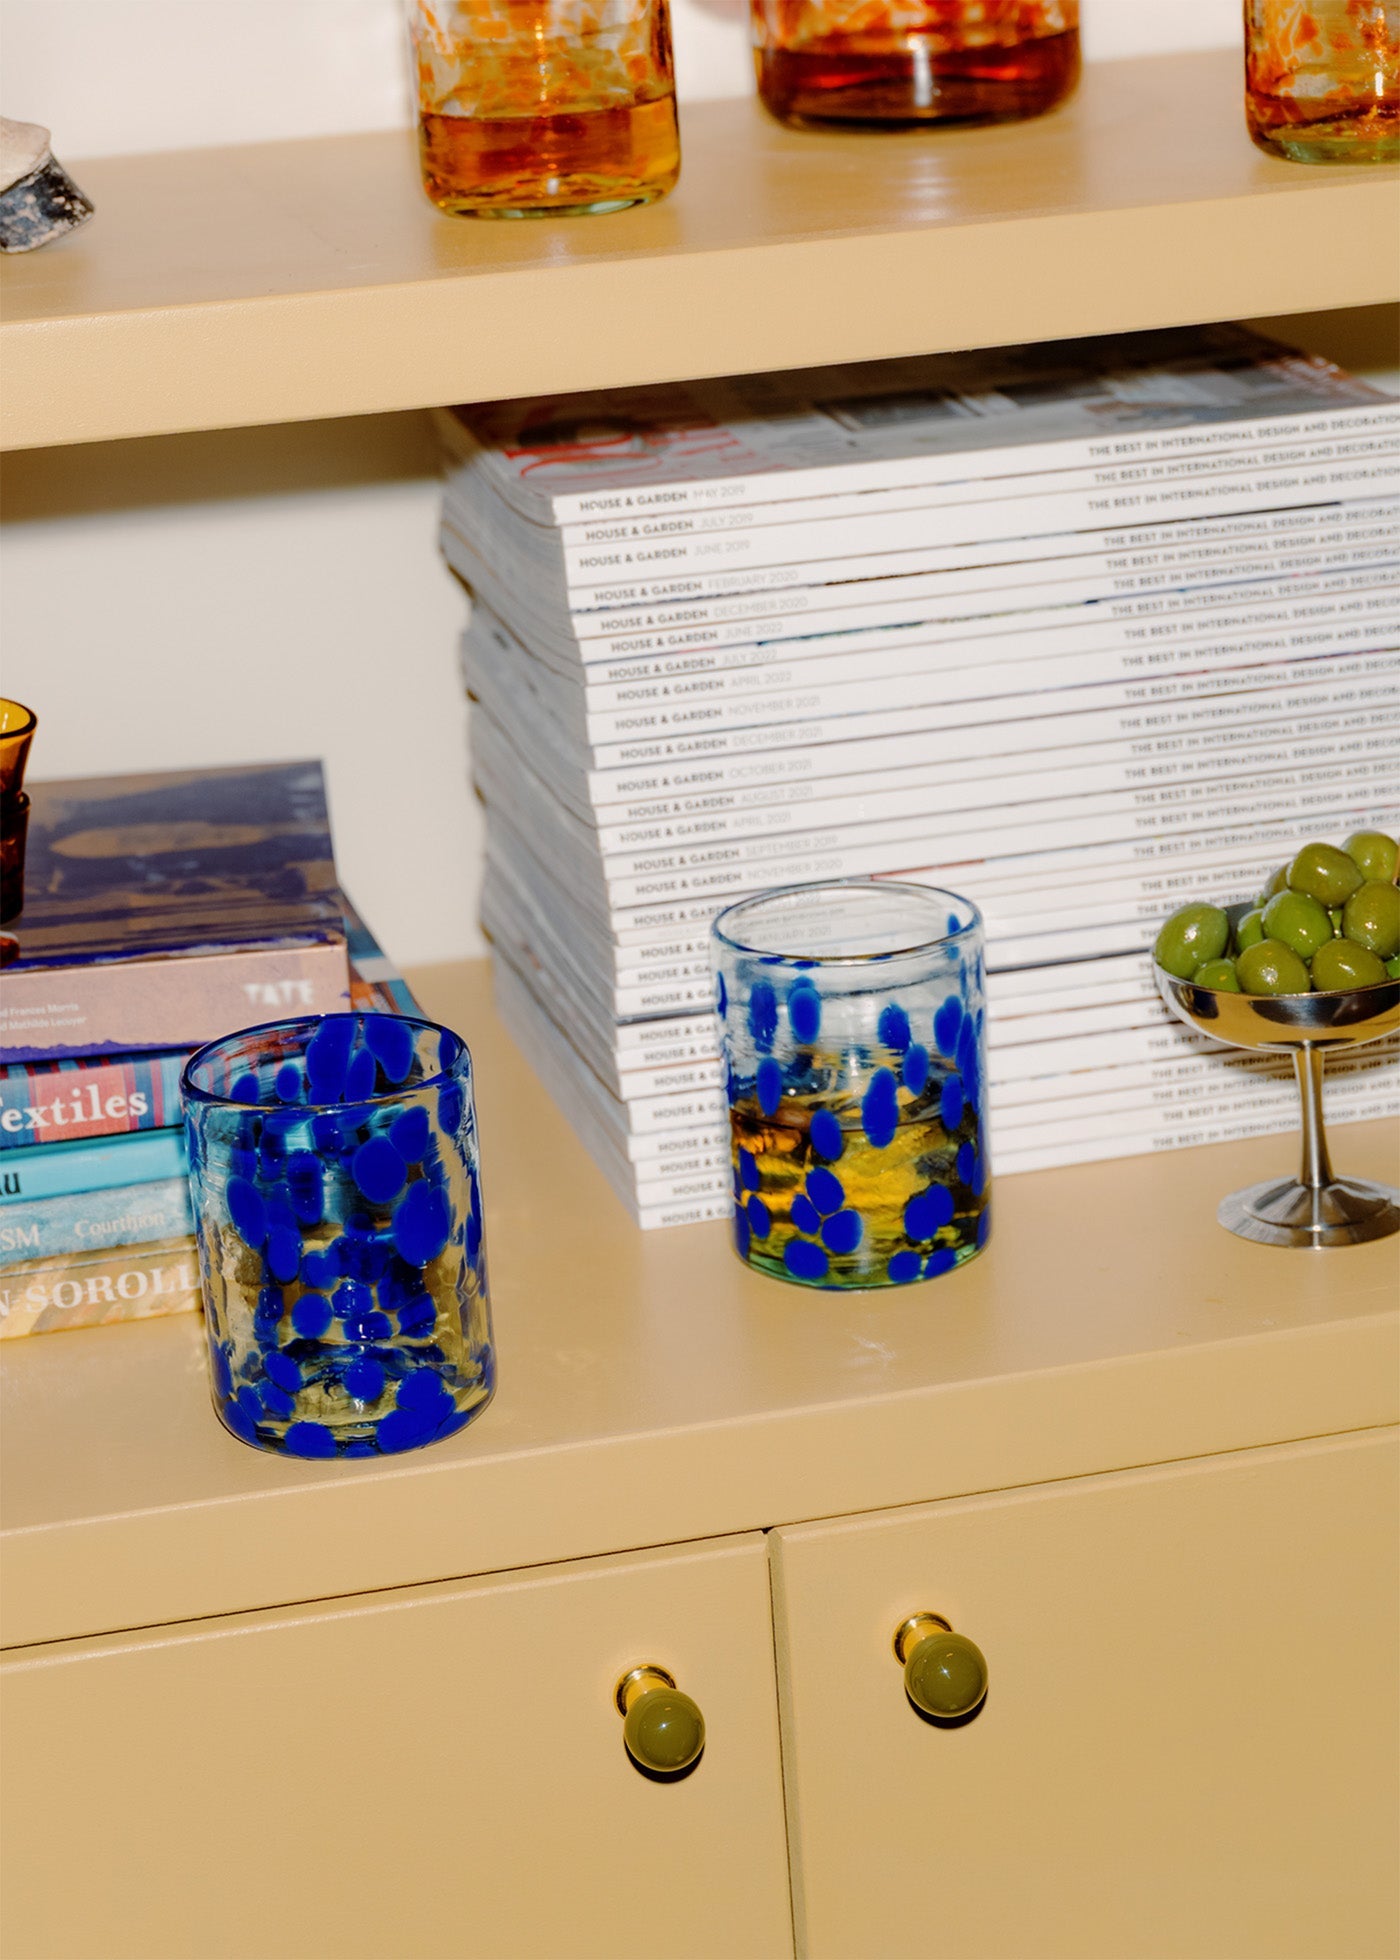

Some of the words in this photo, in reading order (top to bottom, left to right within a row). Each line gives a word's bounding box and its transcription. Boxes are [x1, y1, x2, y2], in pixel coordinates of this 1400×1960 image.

[1089, 445, 1110, 456] THE
[1114, 442, 1141, 453] BEST
[1146, 440, 1157, 450] IN
[1161, 430, 1252, 449] INTERNATIONAL
[1258, 426, 1299, 439] DESIGN
[1304, 423, 1327, 434] AND
[1095, 471, 1116, 482] THE
[1120, 468, 1147, 480] BEST
[1152, 466, 1163, 476] IN
[1167, 456, 1258, 475] INTERNATIONAL
[1263, 451, 1305, 465] DESIGN
[1310, 449, 1333, 460] AND
[580, 498, 621, 512] HOUSE
[626, 497, 632, 507] &
[636, 491, 686, 506] GARDEN
[1088, 498, 1109, 509] THE
[1114, 495, 1140, 507] BEST
[1146, 493, 1156, 503] IN
[1160, 483, 1252, 502] INTERNATIONAL
[1256, 478, 1298, 492] DESIGN
[1303, 475, 1326, 487] AND
[586, 527, 627, 541] HOUSE
[632, 526, 638, 536] &
[643, 520, 692, 535] GARDEN
[1104, 534, 1124, 546] THE
[1129, 531, 1156, 543] BEST
[1161, 529, 1172, 539] IN
[1177, 519, 1267, 538] INTERNATIONAL
[1272, 514, 1314, 527] DESIGN
[1319, 511, 1342, 522] AND
[579, 554, 621, 568] HOUSE
[625, 553, 632, 563] &
[637, 547, 686, 562] GARDEN
[1107, 557, 1127, 568] THE
[1132, 554, 1158, 565] BEST
[1164, 552, 1174, 562] IN
[1178, 541, 1268, 560] INTERNATIONAL
[1273, 536, 1315, 550] DESIGN
[1320, 533, 1342, 545] AND
[594, 587, 636, 601] HOUSE
[640, 586, 647, 596] &
[651, 580, 702, 595] GARDEN
[601, 616, 642, 630] HOUSE
[647, 614, 653, 625] &
[658, 608, 707, 623] GARDEN
[611, 638, 652, 652] HOUSE
[657, 636, 663, 647] &
[668, 630, 717, 645] GARDEN
[609, 665, 649, 679] HOUSE
[654, 663, 661, 674] &
[665, 657, 715, 672] GARDEN
[617, 686, 658, 700] HOUSE
[663, 685, 669, 695] &
[673, 679, 724, 694] GARDEN
[615, 715, 656, 729] HOUSE
[660, 714, 667, 724] &
[671, 707, 721, 723] GARDEN
[620, 745, 661, 759] HOUSE
[666, 744, 672, 754] &
[677, 737, 726, 753] GARDEN
[617, 777, 658, 792] HOUSE
[663, 776, 669, 786] &
[673, 770, 722, 785] GARDEN
[628, 803, 668, 817] HOUSE
[673, 802, 680, 812] &
[684, 795, 734, 810] GARDEN
[620, 828, 661, 842] HOUSE
[666, 826, 672, 837] &
[677, 820, 726, 835] GARDEN
[633, 856, 675, 871] HOUSE
[679, 855, 686, 865] &
[690, 848, 739, 864] GARDEN
[636, 879, 676, 894] HOUSE
[681, 878, 687, 888] &
[692, 871, 741, 887] GARDEN
[633, 911, 674, 926] HOUSE
[679, 909, 685, 920] &
[641, 943, 680, 958] HOUSE
[686, 942, 692, 952] &
[243, 979, 314, 1006] TATE
[640, 1027, 680, 1042] HOUSE
[685, 1025, 691, 1036] &
[654, 1071, 694, 1086] HOUSE
[700, 1069, 706, 1080] &
[0, 1083, 149, 1133] extiles
[660, 1159, 700, 1174] HOUSE
[705, 1157, 711, 1167] &
[661, 1209, 701, 1224] HOUSE
[706, 1207, 712, 1217] &
